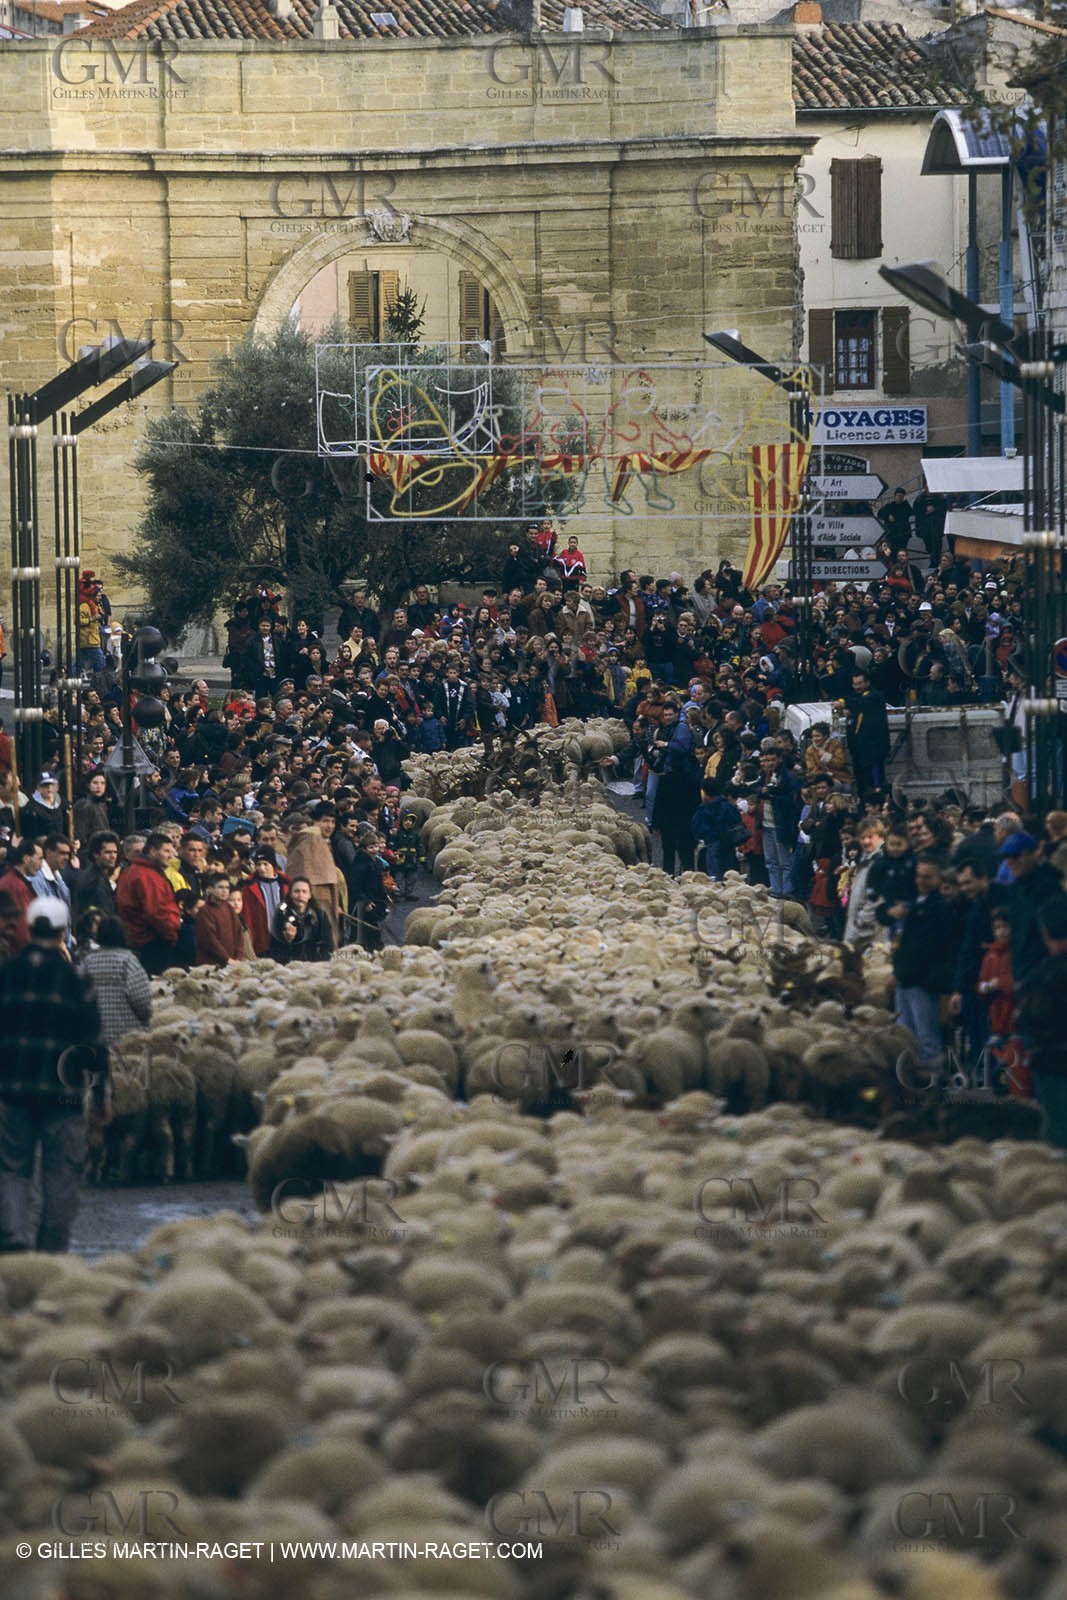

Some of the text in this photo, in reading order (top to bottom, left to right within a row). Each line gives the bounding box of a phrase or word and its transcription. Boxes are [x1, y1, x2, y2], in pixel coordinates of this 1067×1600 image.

[808, 409, 925, 428] VOYAGES
[826, 428, 926, 441] Licence A 912
[823, 565, 870, 575] DIRECTIONS
